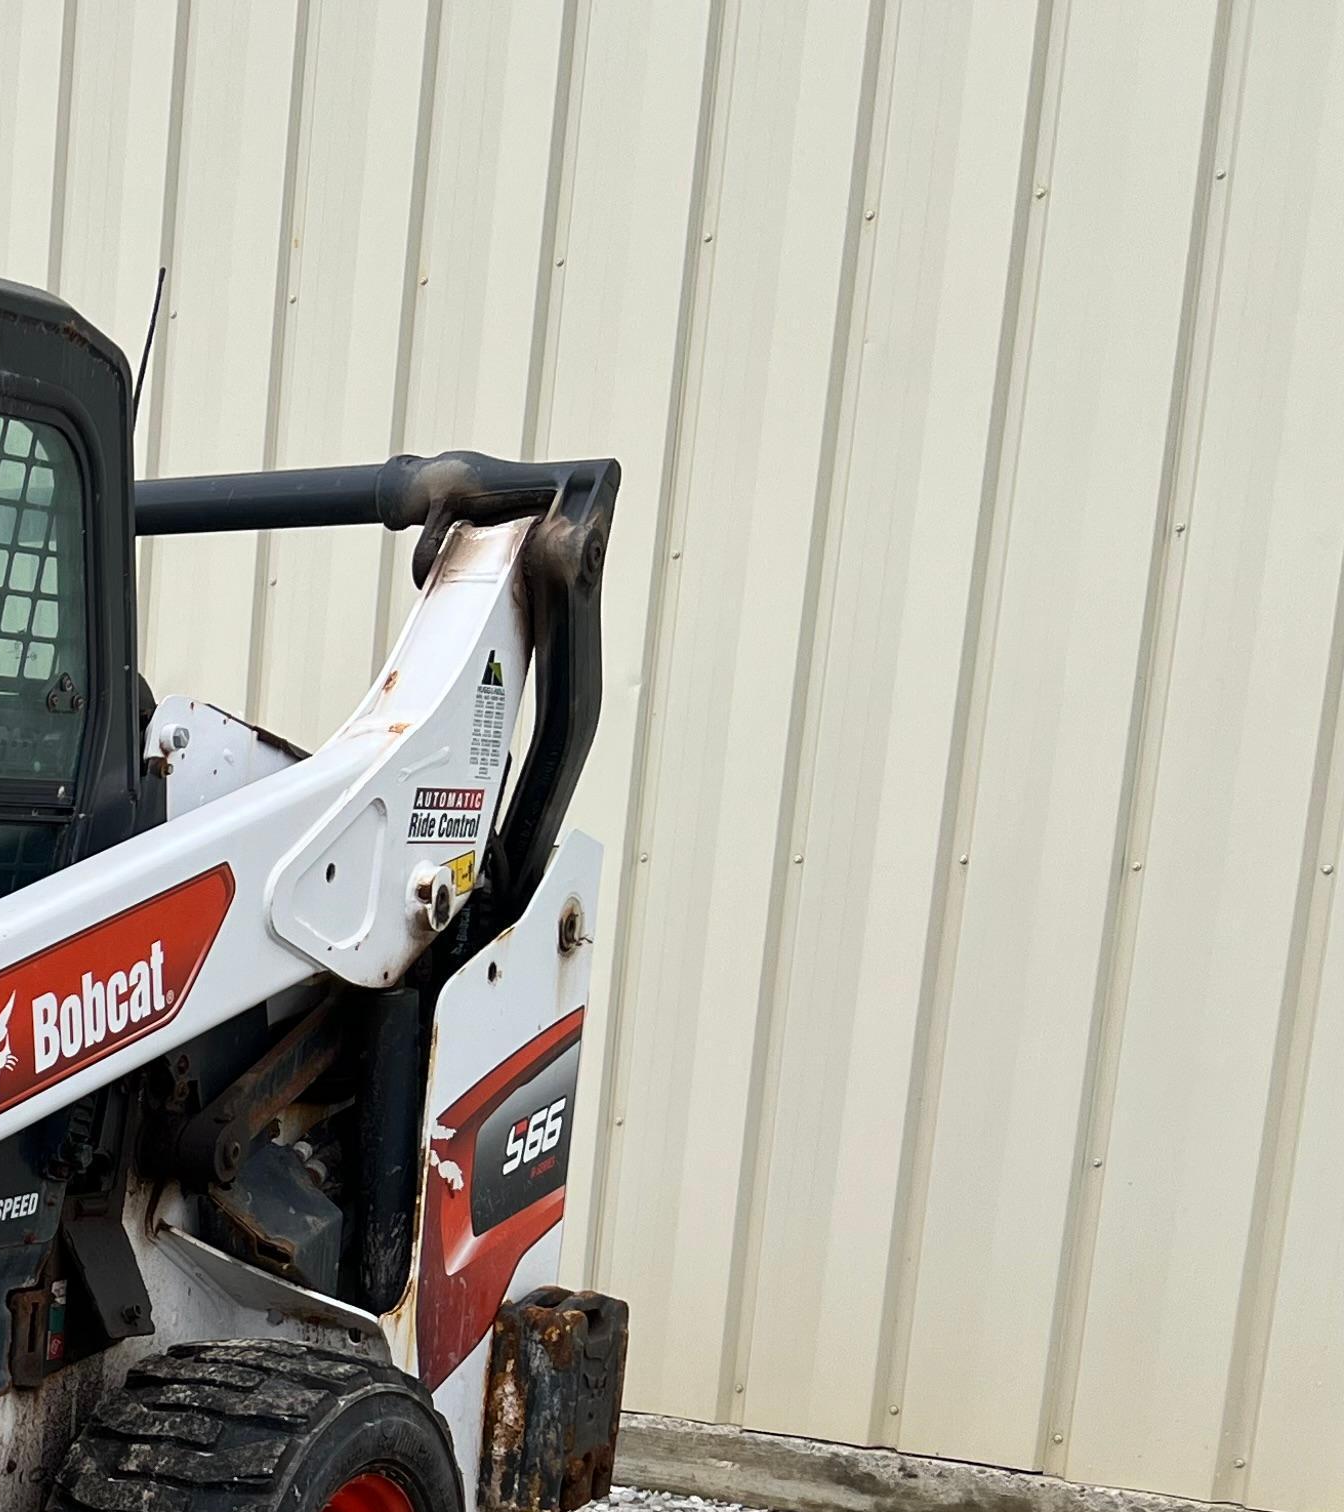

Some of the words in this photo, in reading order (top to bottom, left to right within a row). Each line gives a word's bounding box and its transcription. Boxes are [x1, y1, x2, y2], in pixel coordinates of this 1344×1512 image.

[407, 812, 436, 838] Ride
[438, 812, 481, 838] Control
[416, 791, 482, 808] AUTOMATIC
[32, 939, 166, 1075] Bobcat
[502, 1096, 568, 1176] S66
